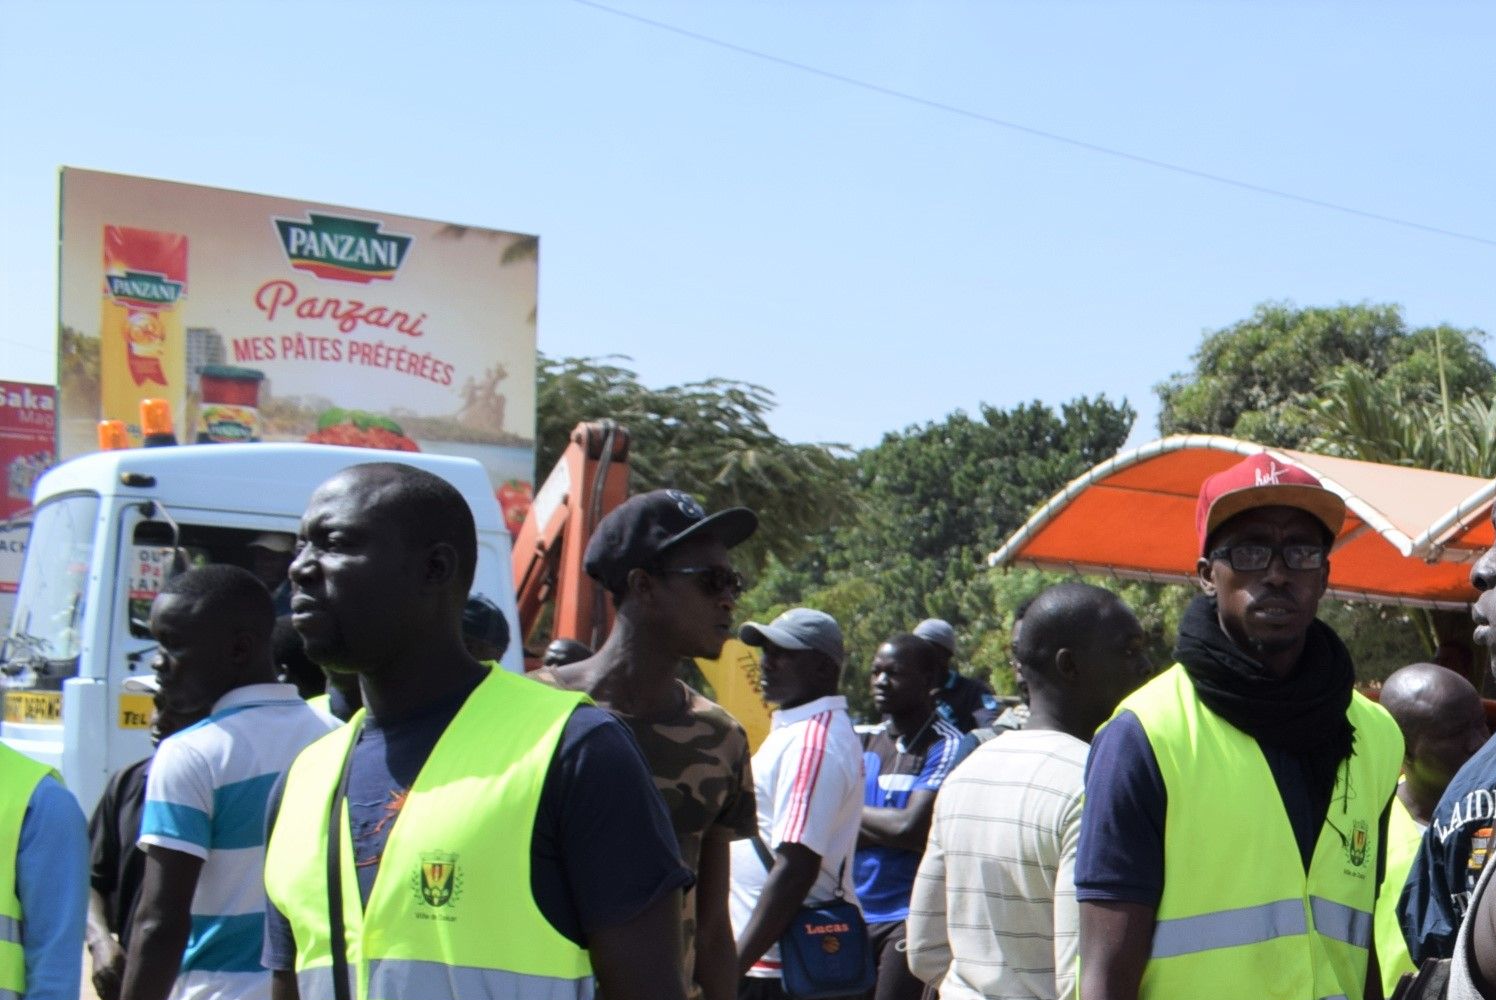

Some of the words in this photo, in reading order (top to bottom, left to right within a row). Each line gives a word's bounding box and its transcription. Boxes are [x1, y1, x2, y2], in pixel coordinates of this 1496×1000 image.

[287, 225, 399, 267] PANZANI
[113, 280, 178, 301] PANZANI
[255, 279, 428, 337] Panzani
[232, 335, 277, 363] MES
[280, 332, 344, 363] PÂTES
[348, 339, 455, 386] PRÉFÉRÉES
[123, 711, 147, 725] TEL
